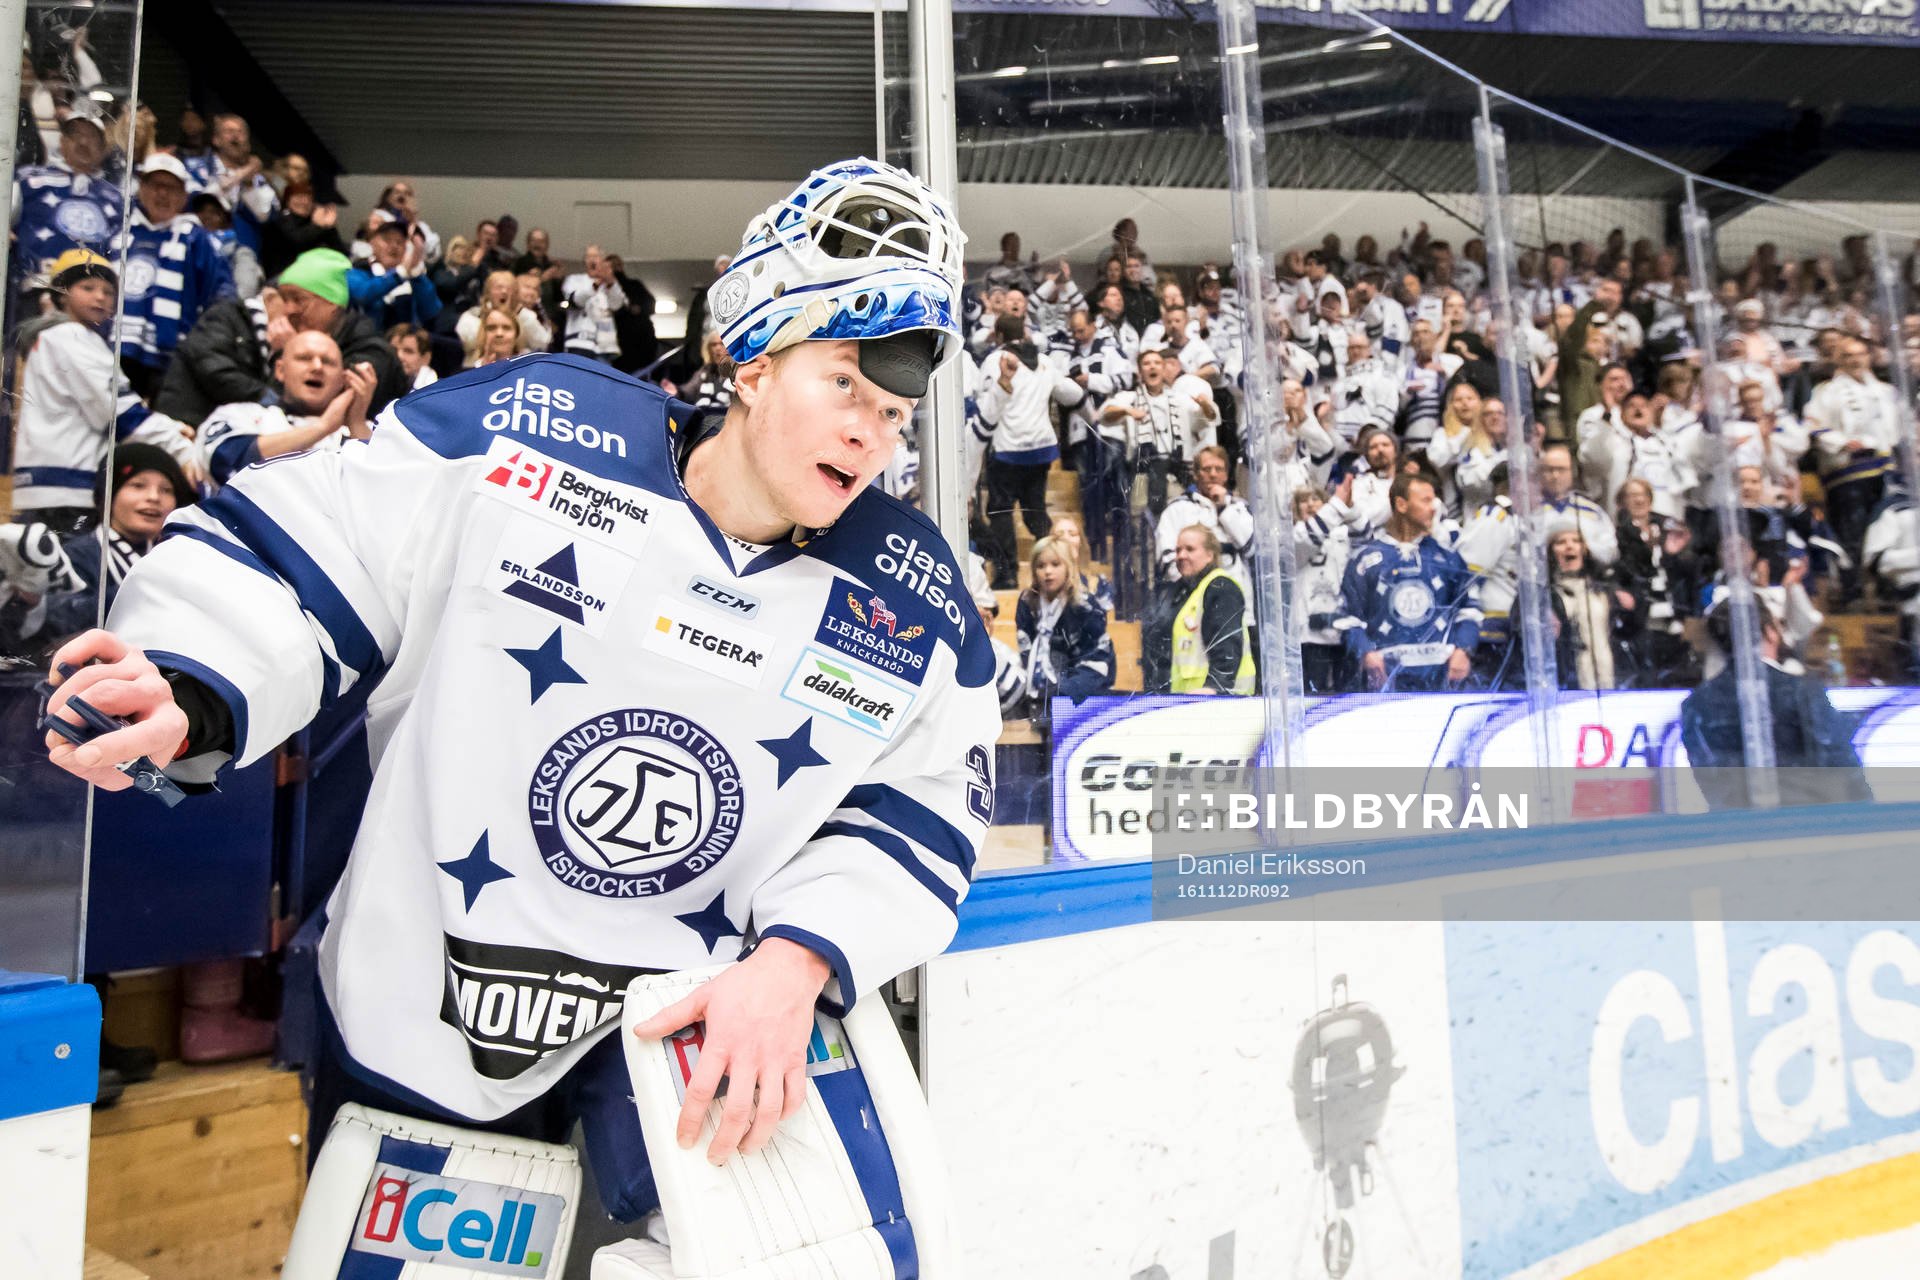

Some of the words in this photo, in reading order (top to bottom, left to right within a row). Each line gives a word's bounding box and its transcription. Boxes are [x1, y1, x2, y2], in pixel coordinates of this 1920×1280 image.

[489, 377, 576, 411] clas
[482, 400, 627, 458] ohlson
[549, 491, 616, 533] Insjön
[558, 470, 649, 524] Bergkvist
[885, 533, 953, 585] clas
[500, 559, 606, 612] ERLANDSSON
[691, 582, 756, 612] CCM
[825, 615, 924, 670] LEKSANDS
[836, 638, 904, 674] KNÄCKEBRÖD
[803, 673, 895, 721] dalakraft
[533, 716, 619, 826] LEKSANDS
[624, 712, 744, 873] IDROTTSFÖRENING
[546, 850, 667, 897] ISHOCKEY
[1589, 887, 1920, 1195] clas
